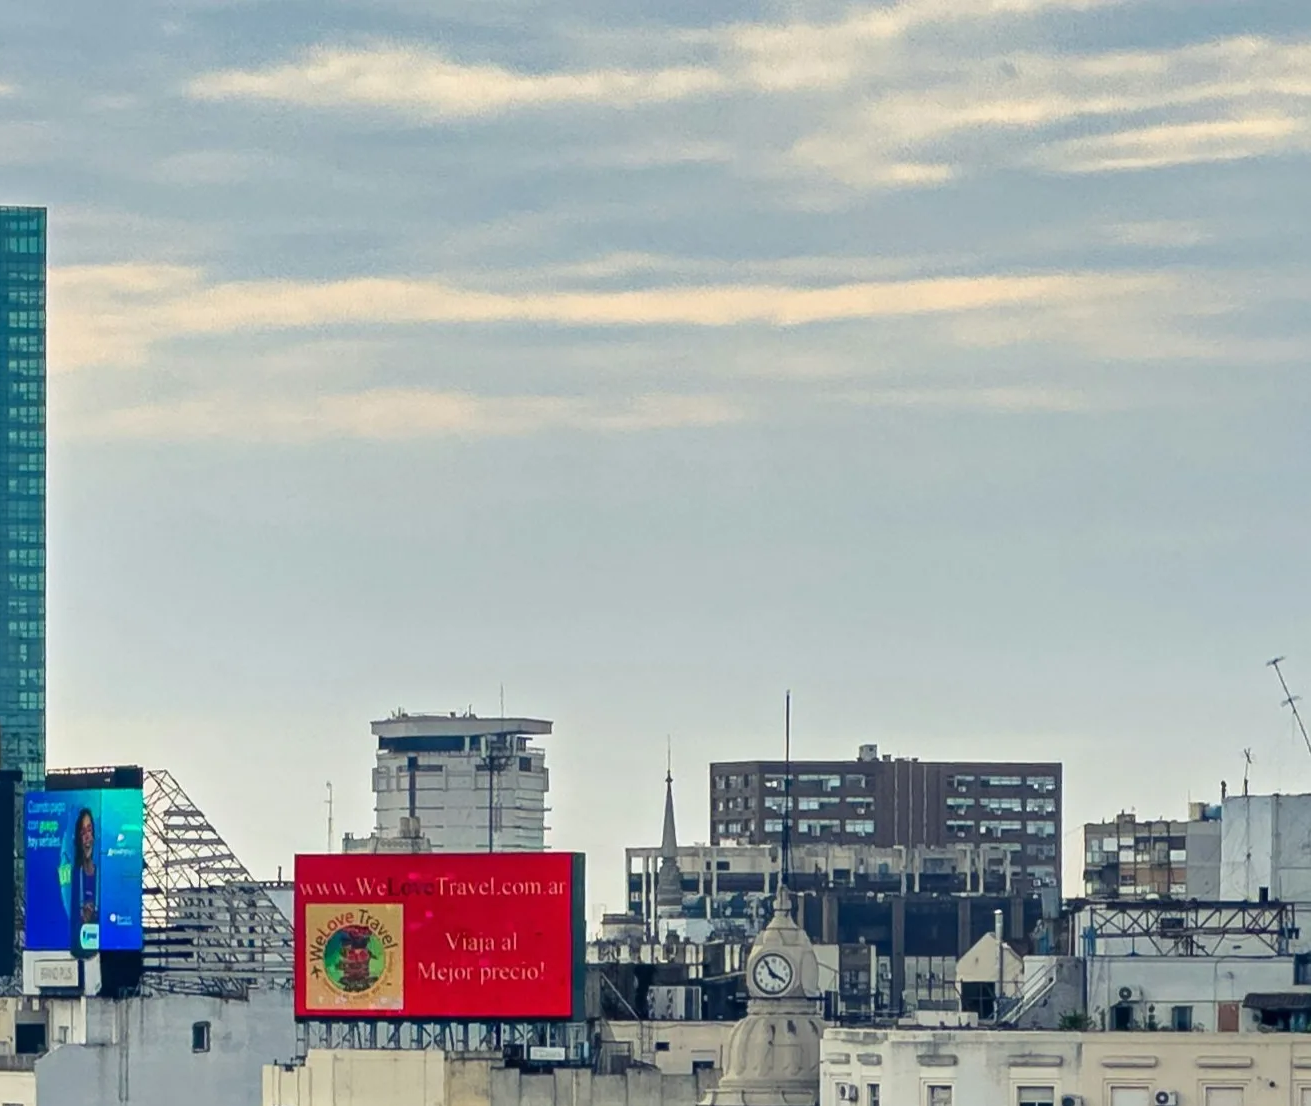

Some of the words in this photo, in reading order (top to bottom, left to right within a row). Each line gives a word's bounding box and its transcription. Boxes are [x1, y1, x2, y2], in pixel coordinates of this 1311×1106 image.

[299, 876, 567, 897] www.WeLoveTravel.com.ar
[358, 908, 399, 950] Travel
[445, 932, 495, 956] Viaja
[501, 932, 518, 951] al
[417, 962, 474, 986] Mejor
[479, 961, 546, 985] precio!
